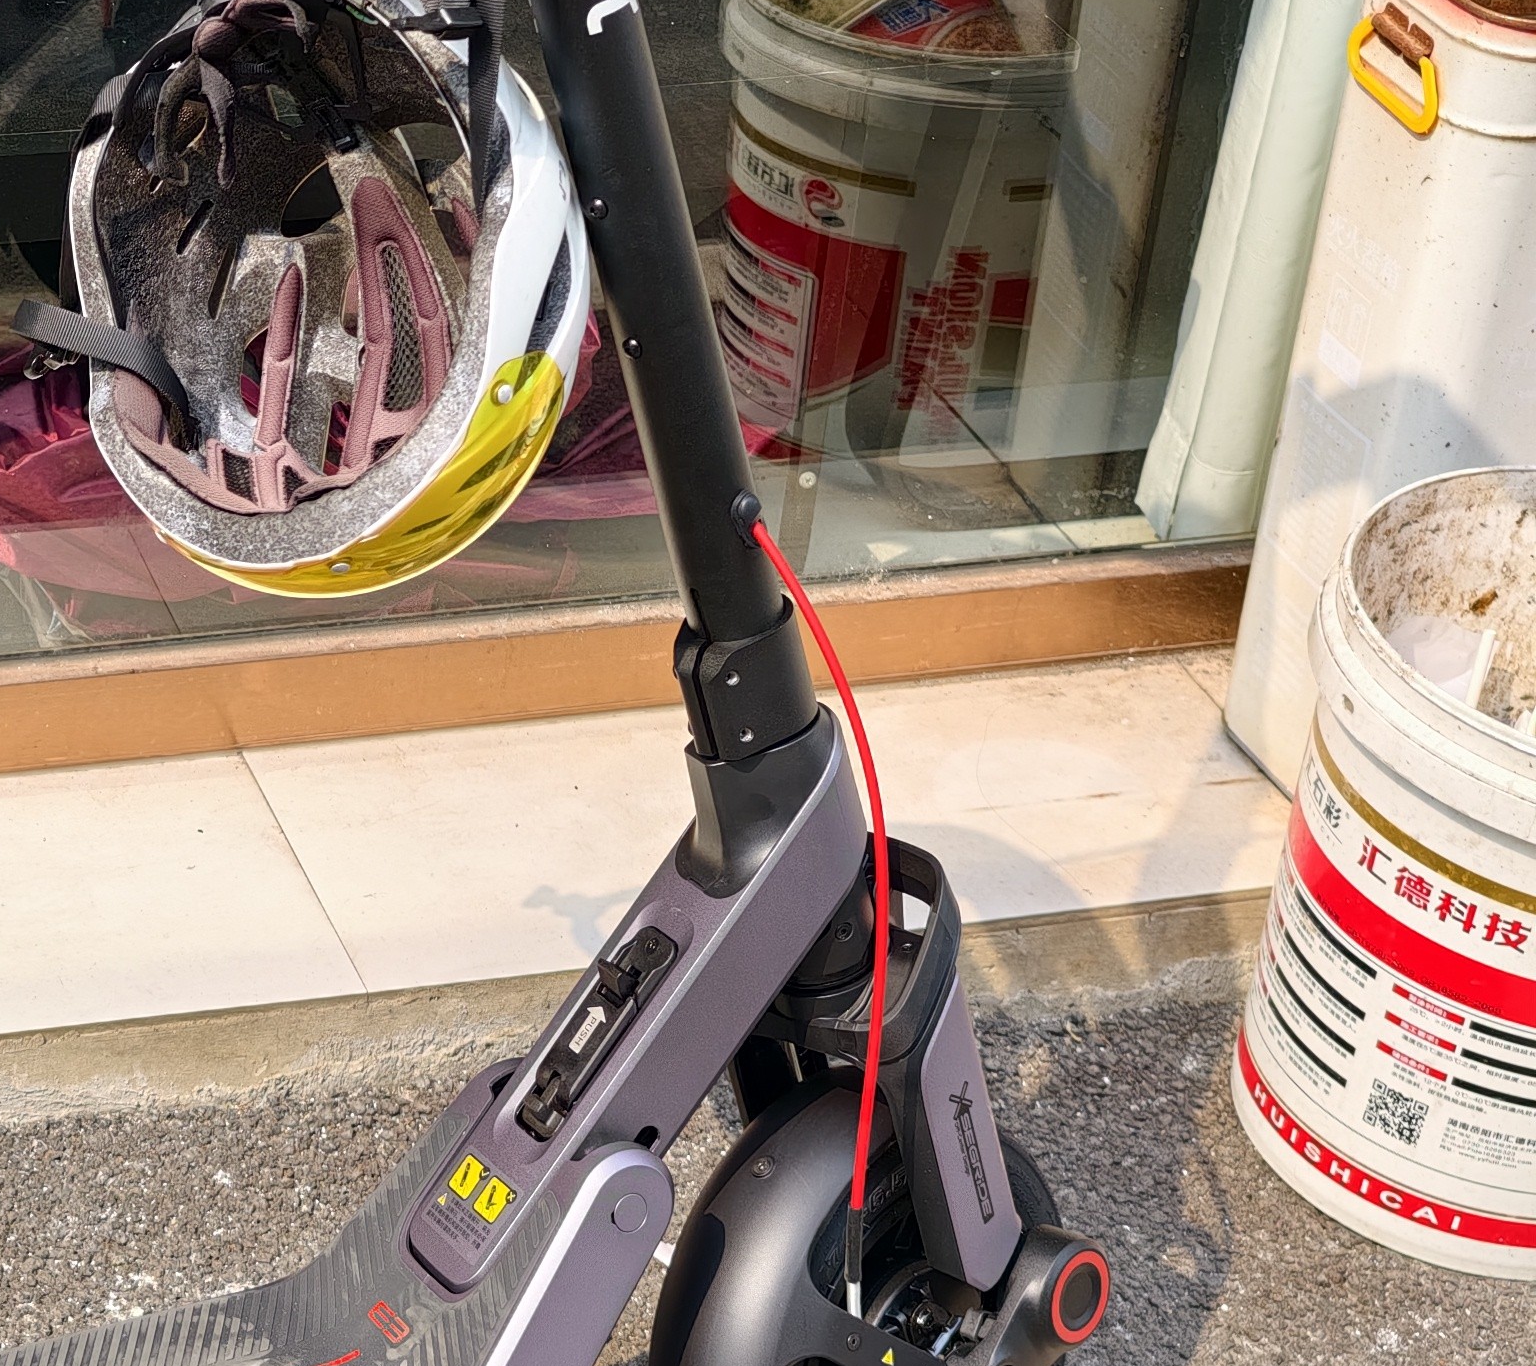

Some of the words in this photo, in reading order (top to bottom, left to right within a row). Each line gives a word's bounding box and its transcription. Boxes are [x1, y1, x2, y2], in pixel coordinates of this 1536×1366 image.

[1357, 834, 1532, 954] 汇德科技
[571, 1014, 598, 1049] PUSH
[1253, 1082, 1462, 1231] HUISHICAI
